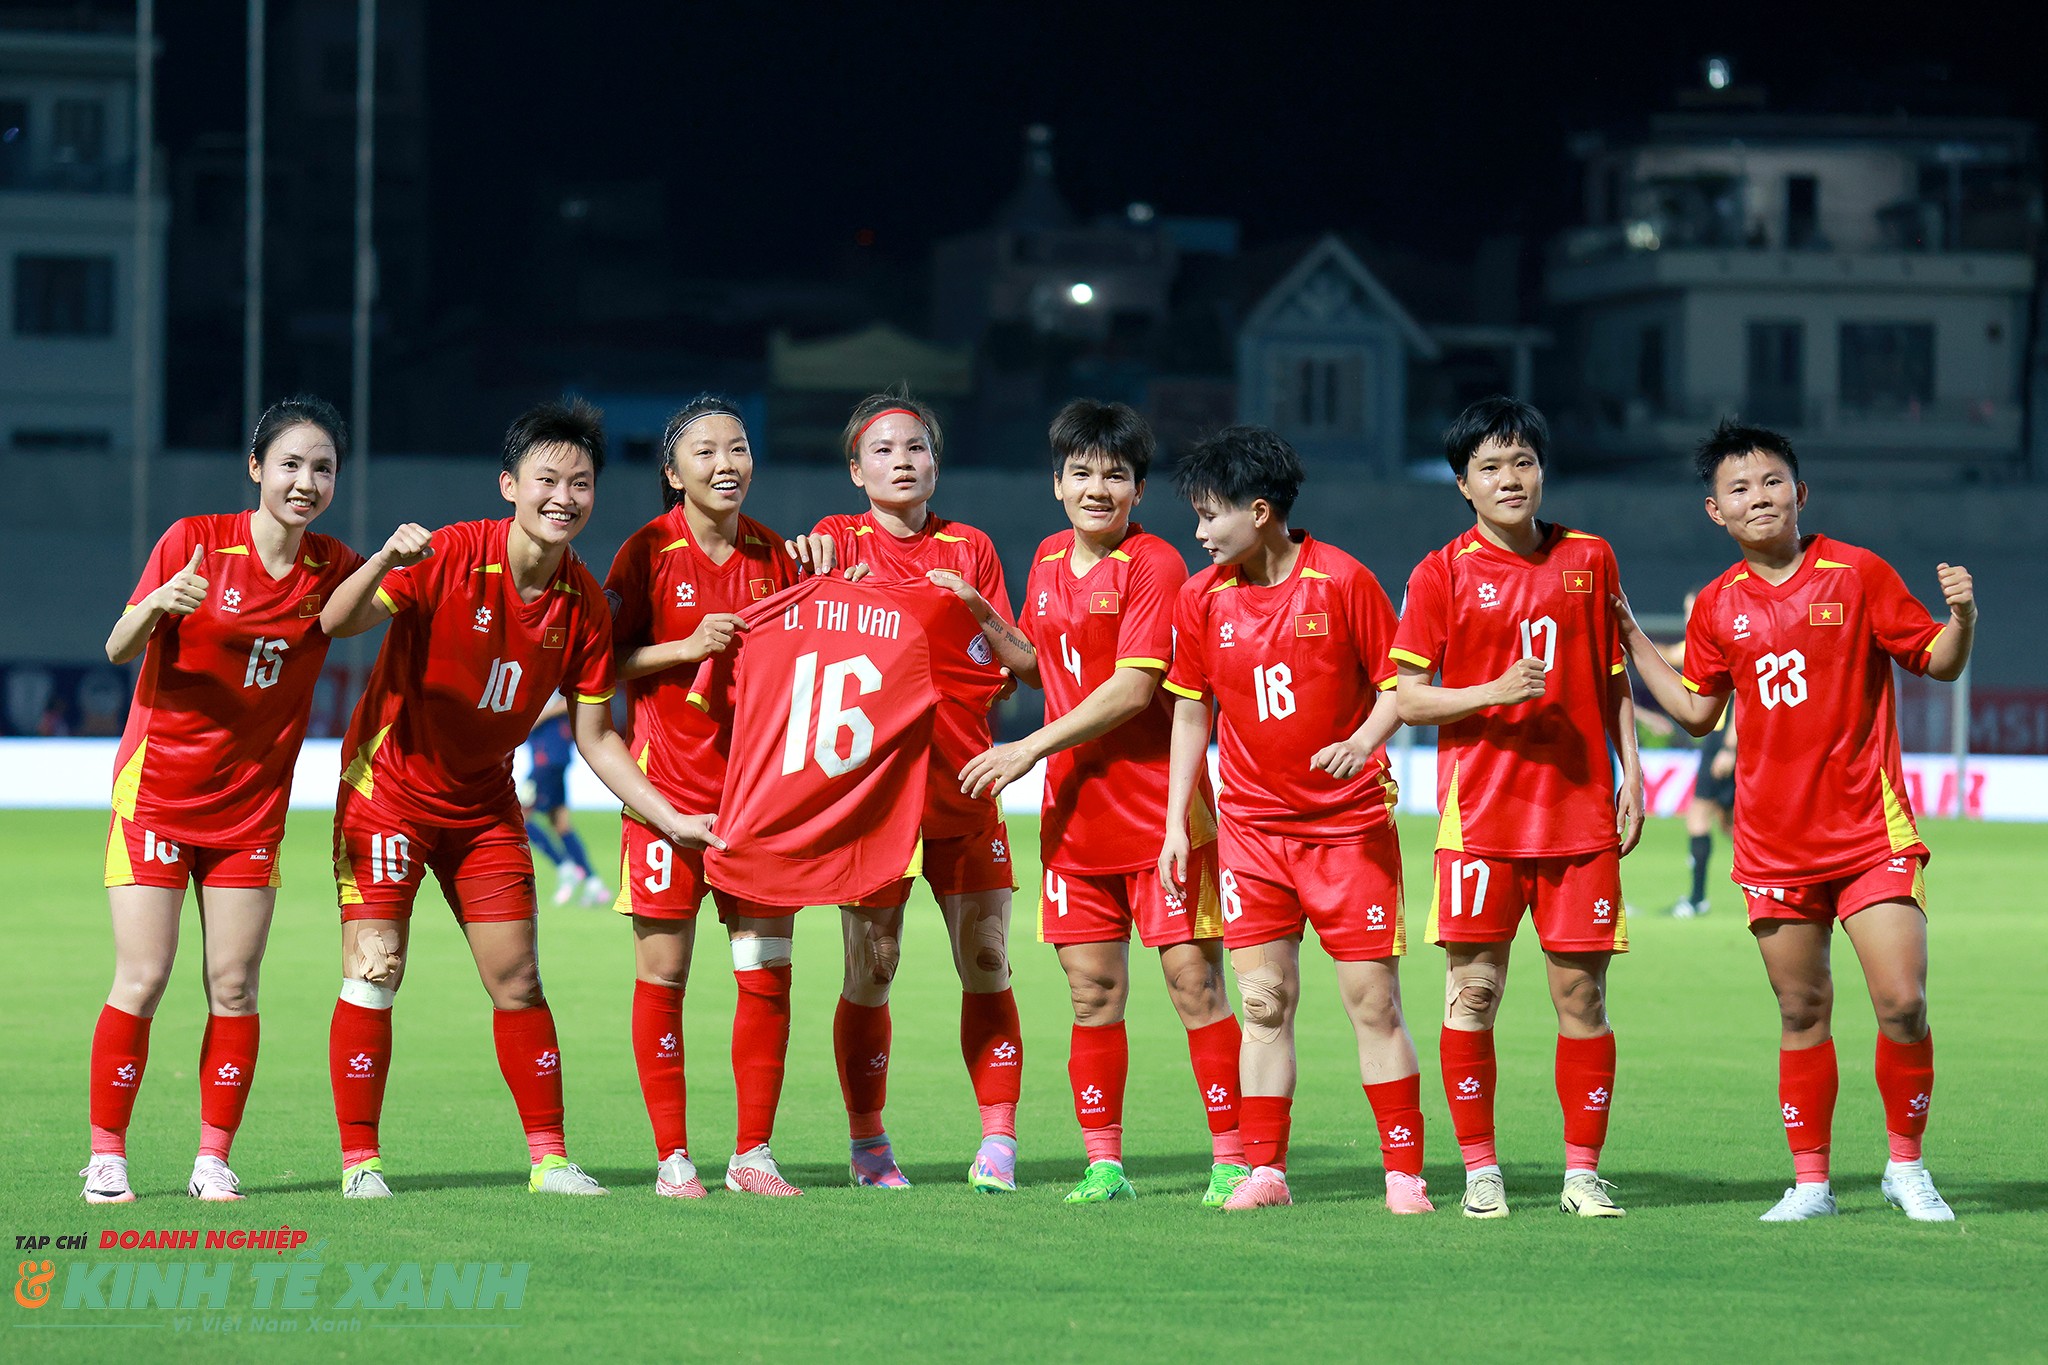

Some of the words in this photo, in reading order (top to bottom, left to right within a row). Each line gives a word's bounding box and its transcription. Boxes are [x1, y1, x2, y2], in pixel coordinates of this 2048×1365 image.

[815, 600, 850, 632] THI
[857, 604, 901, 640] VAN
[244, 636, 290, 689] 15
[477, 657, 523, 713] 10
[1059, 632, 1082, 687] 4
[1755, 648, 1808, 711] 23
[781, 650, 883, 779] 16
[1253, 661, 1297, 723] 18
[371, 832, 411, 884] 10
[645, 838, 673, 894] 9
[1046, 868, 1068, 918] 4
[1451, 859, 1490, 918] 17
